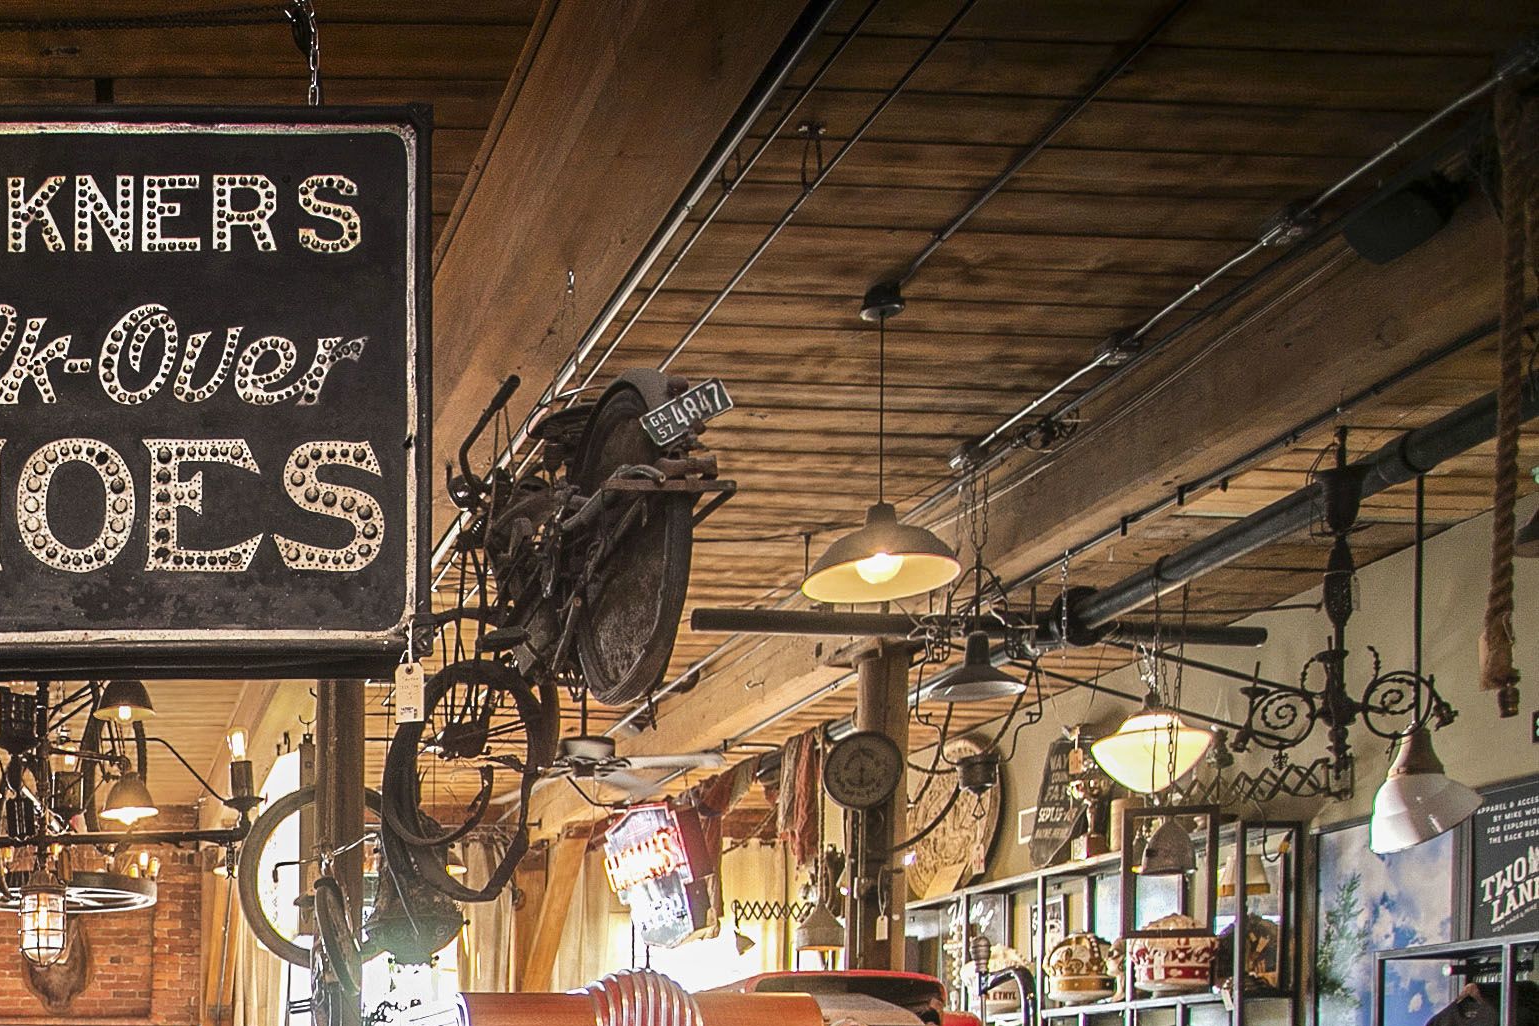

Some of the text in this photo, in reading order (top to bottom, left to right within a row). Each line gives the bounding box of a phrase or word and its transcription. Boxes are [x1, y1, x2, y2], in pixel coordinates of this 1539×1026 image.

[649, 383, 722, 427] GA 4847
[657, 423, 674, 439] 57
[1504, 809, 1523, 821] MIKE
[1488, 835, 1502, 845] THE
[1504, 831, 1523, 843] BACK
[1480, 856, 1528, 902] TWO
[993, 990, 1018, 1001] ETHYL
